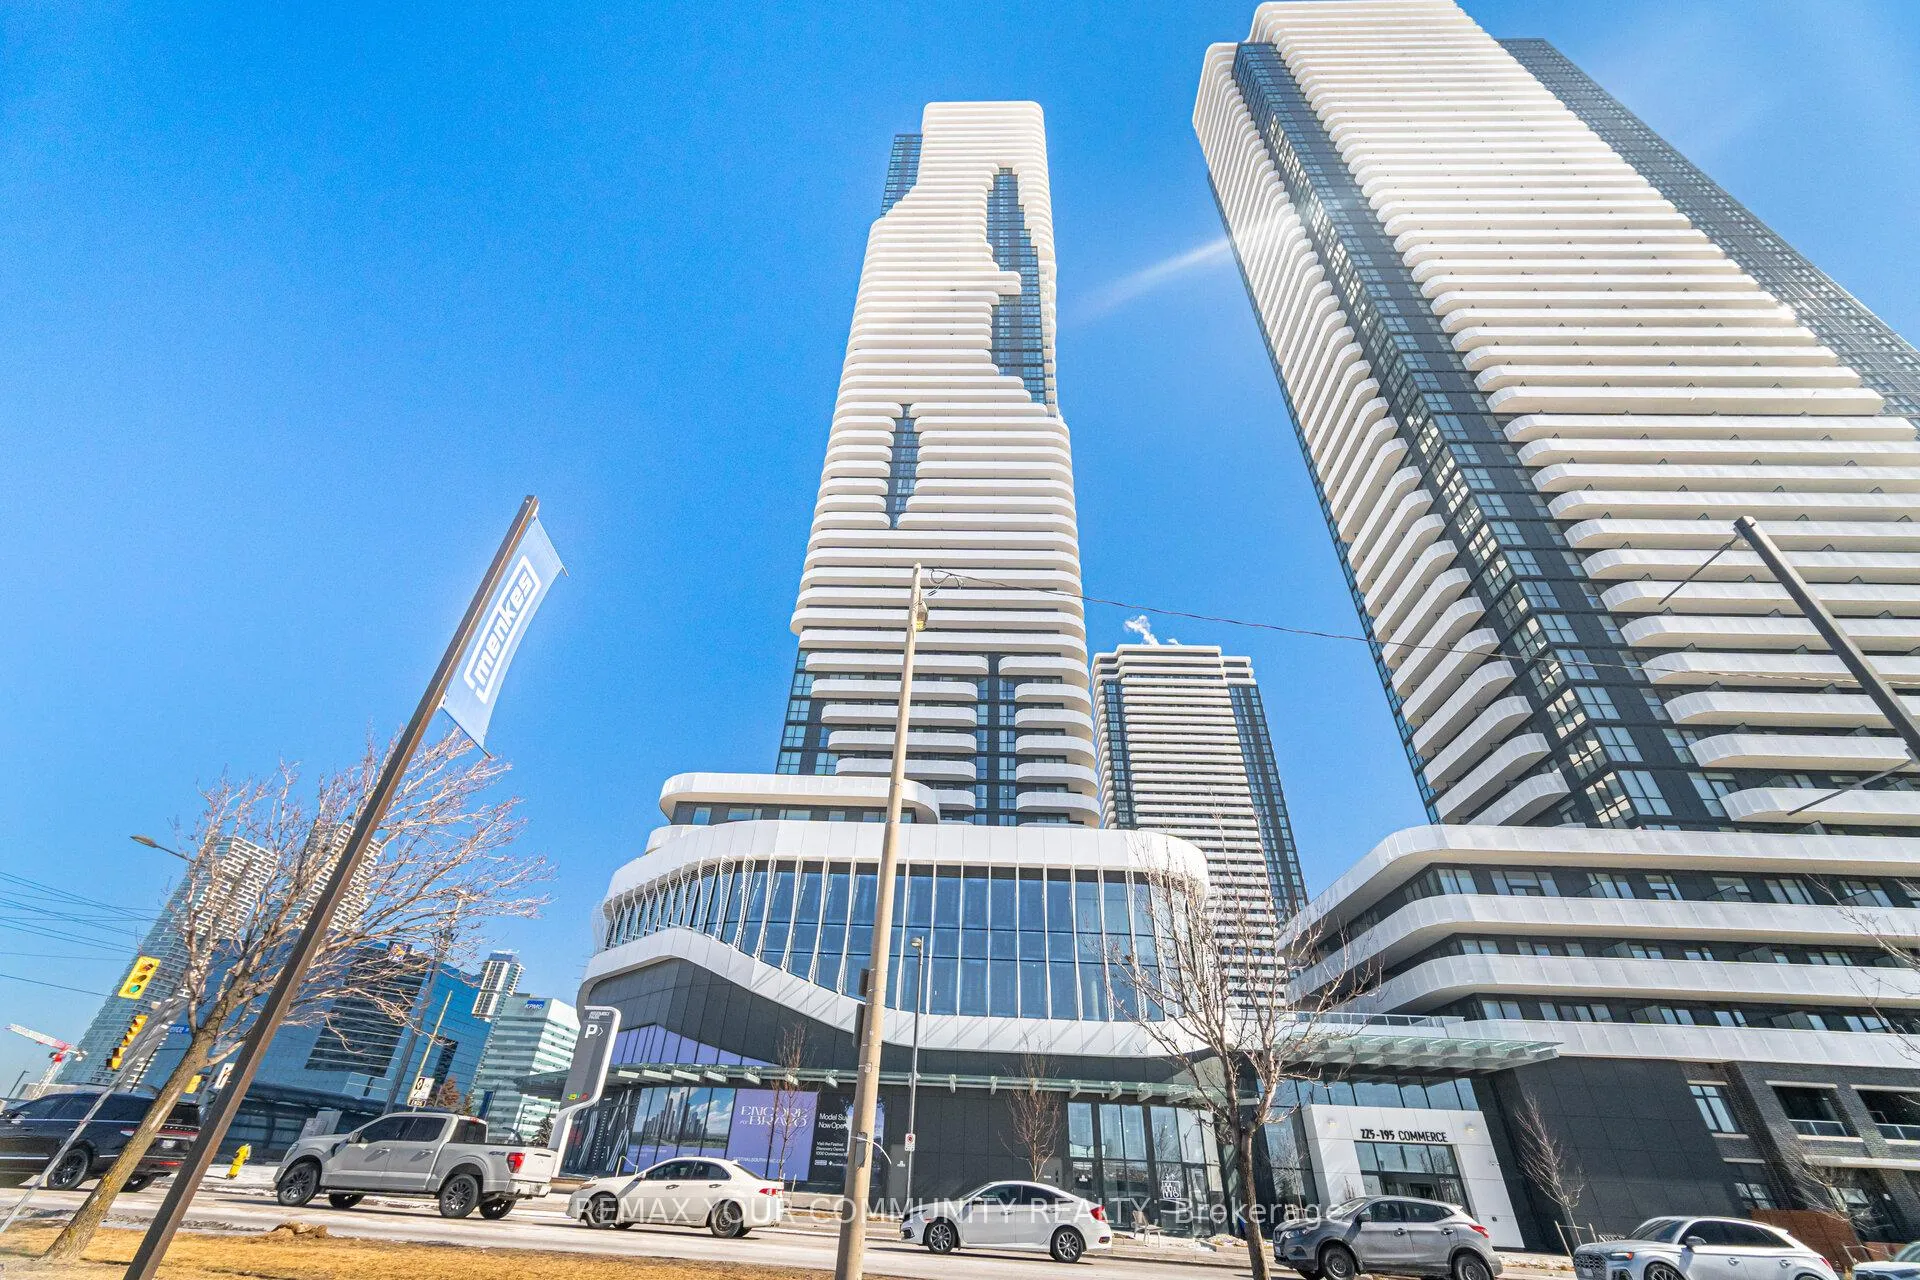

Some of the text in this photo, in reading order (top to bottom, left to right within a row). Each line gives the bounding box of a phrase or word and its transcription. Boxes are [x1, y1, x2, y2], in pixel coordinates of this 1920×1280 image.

[474, 571, 533, 686] menkes
[584, 1024, 598, 1039] P
[818, 1121, 830, 1129] Now
[1360, 1129, 1448, 1142] 225-195 COMMERCE
